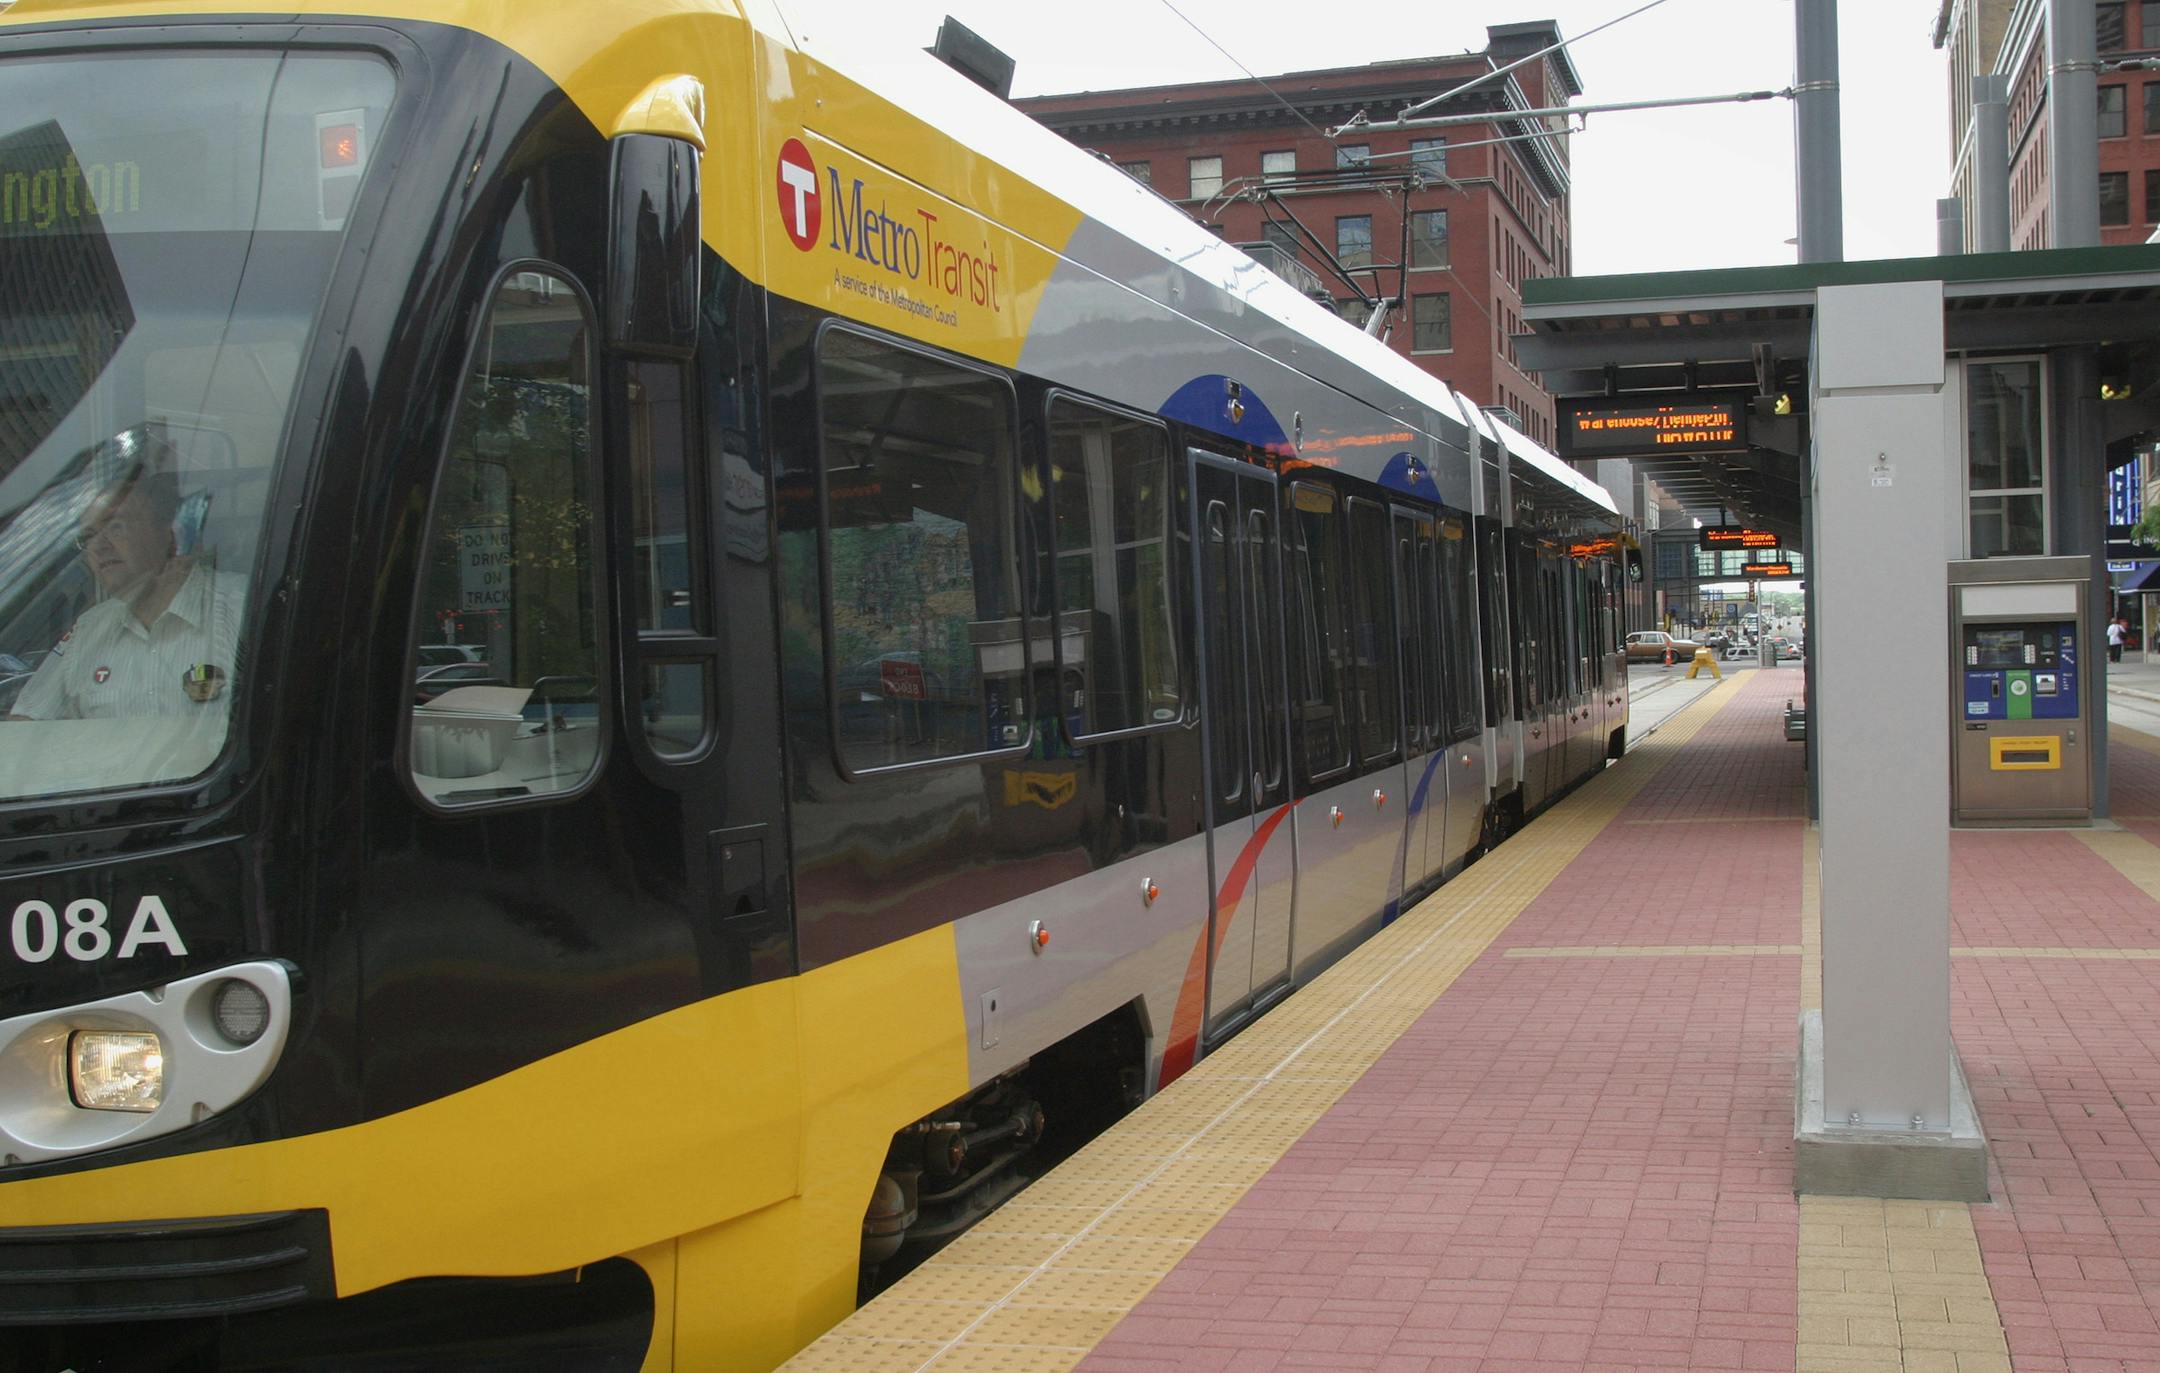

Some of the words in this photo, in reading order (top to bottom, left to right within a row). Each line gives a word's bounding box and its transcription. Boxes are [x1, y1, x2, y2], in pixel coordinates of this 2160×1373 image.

[1, 151, 140, 229] ngton
[781, 159, 816, 238] T
[834, 268, 841, 286] A
[842, 275, 868, 296] service
[869, 280, 877, 298] of
[878, 284, 890, 303] the
[891, 288, 934, 319] Metropolitan
[934, 304, 958, 327] Council
[465, 535, 482, 548] DO
[490, 533, 511, 545] NO
[472, 553, 511, 567] DRIVE
[484, 572, 502, 584] ON
[467, 591, 511, 604] TRACK
[11, 895, 189, 963] 08A
